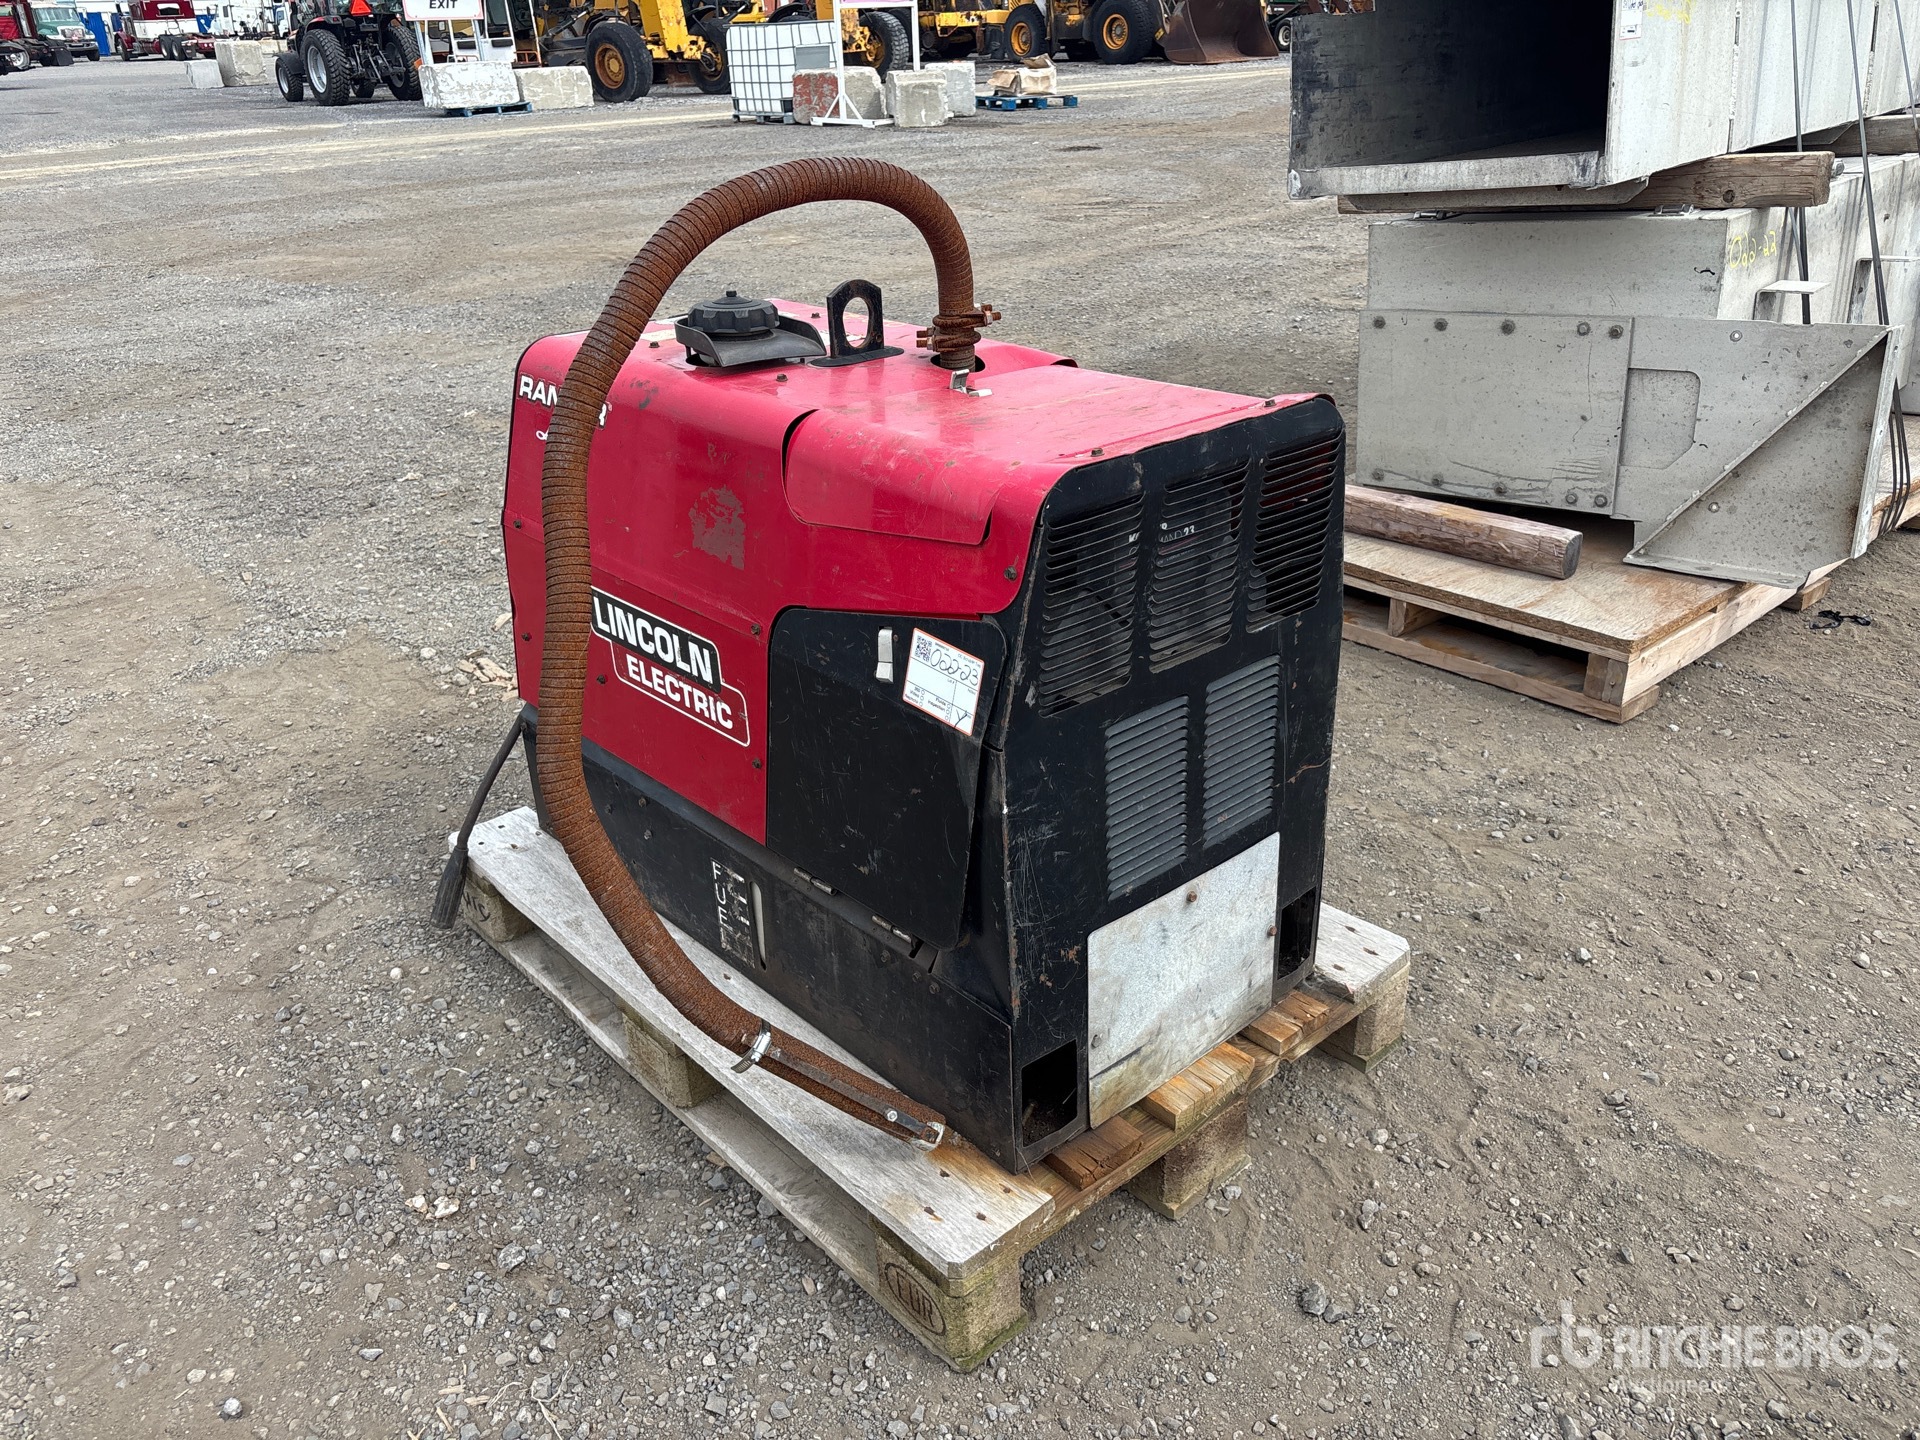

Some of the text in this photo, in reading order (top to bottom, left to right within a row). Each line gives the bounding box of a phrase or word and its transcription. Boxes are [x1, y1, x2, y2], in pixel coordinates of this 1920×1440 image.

[429, 0, 458, 9] EXIT
[592, 594, 715, 684] LINCOLN
[626, 653, 734, 730] ELECTRIC
[895, 1269, 936, 1329] EUR
